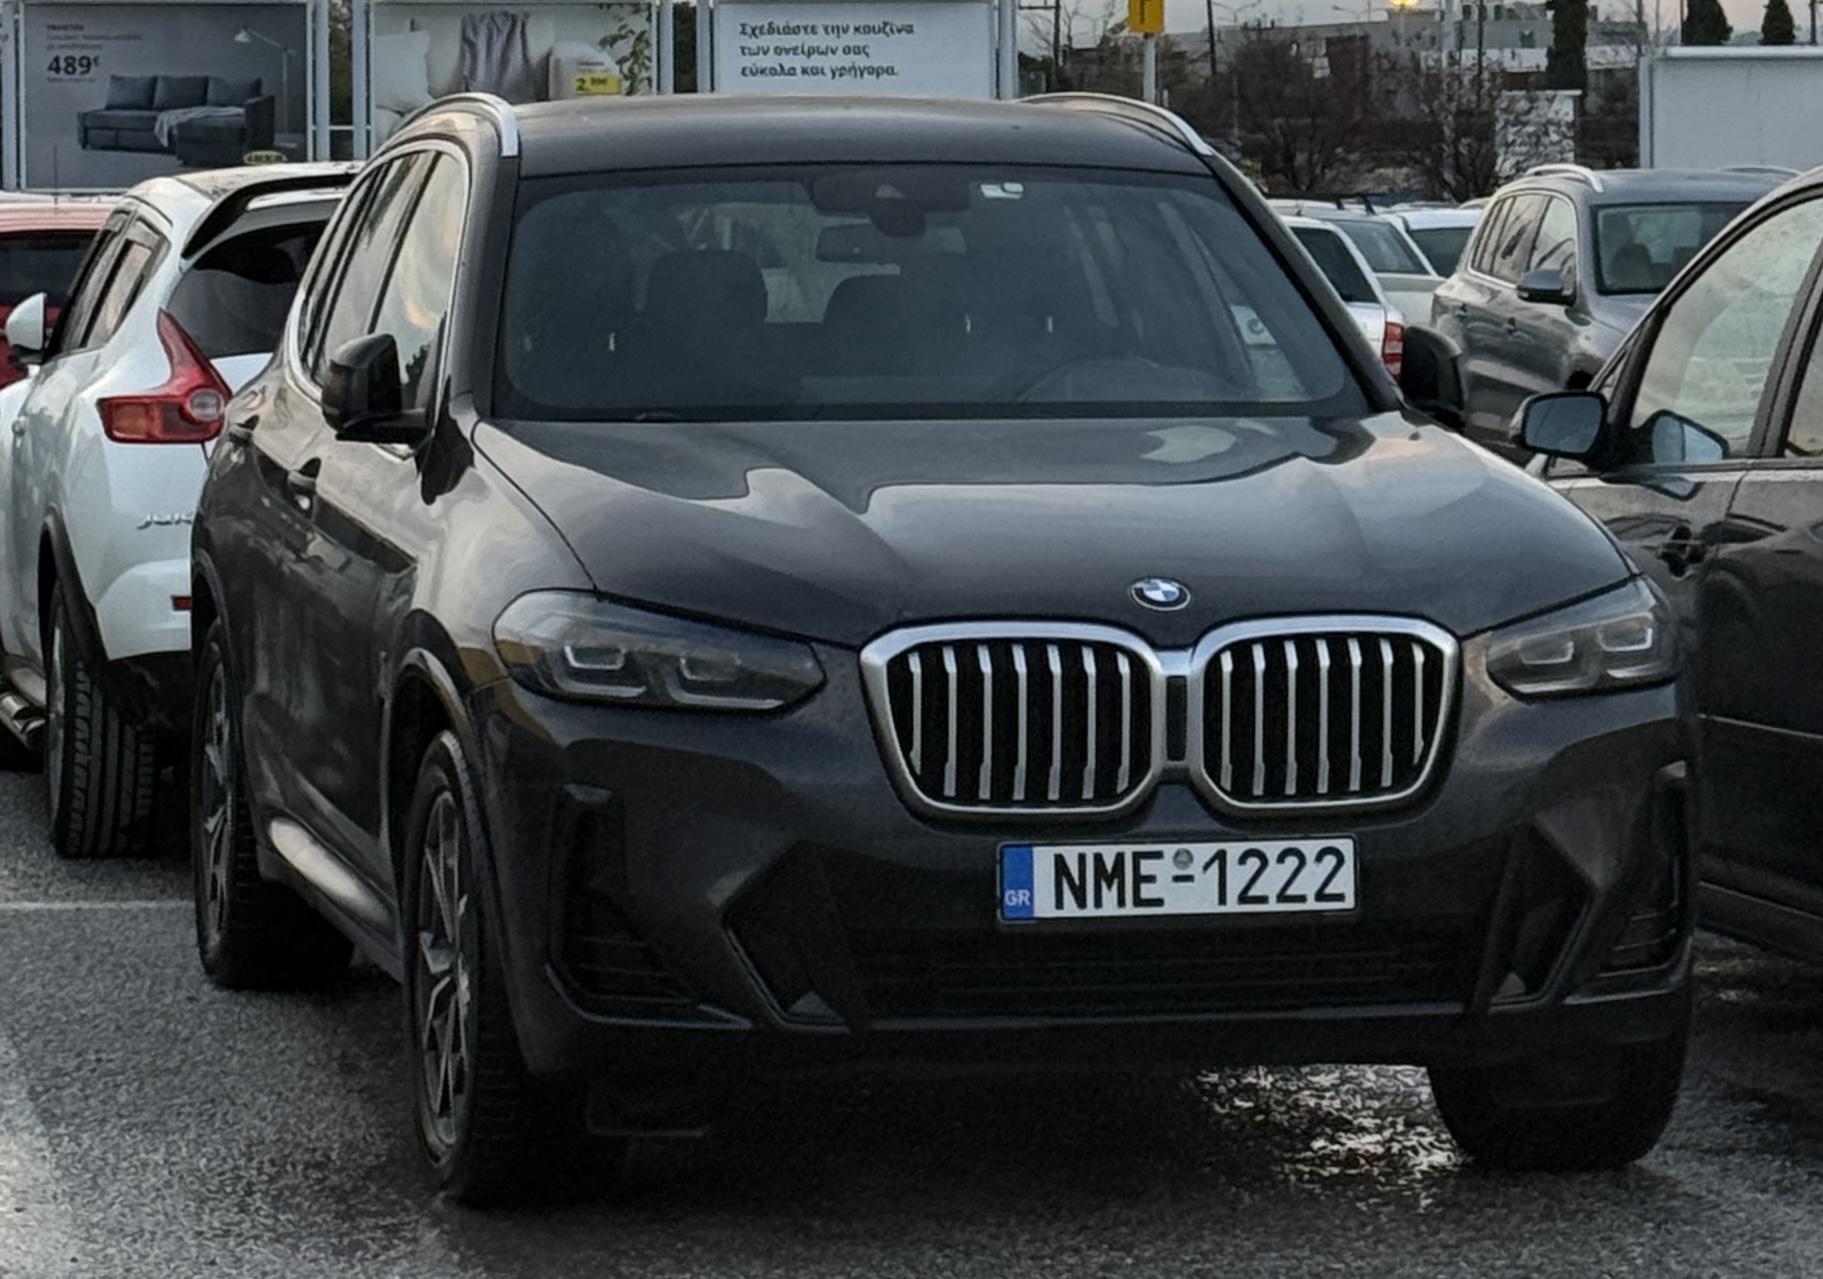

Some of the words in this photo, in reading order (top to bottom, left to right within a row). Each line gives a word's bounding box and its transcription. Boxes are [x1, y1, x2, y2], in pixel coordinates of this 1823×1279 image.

[739, 21, 818, 39] Σχεδιάστε
[822, 23, 849, 39] την
[853, 21, 914, 38] κουζίνα
[739, 44, 771, 57] των
[773, 43, 839, 59] ονείρων
[842, 45, 870, 58] σας
[740, 63, 797, 77] εύκολα
[801, 65, 826, 77] και
[1005, 889, 1031, 907] GR
